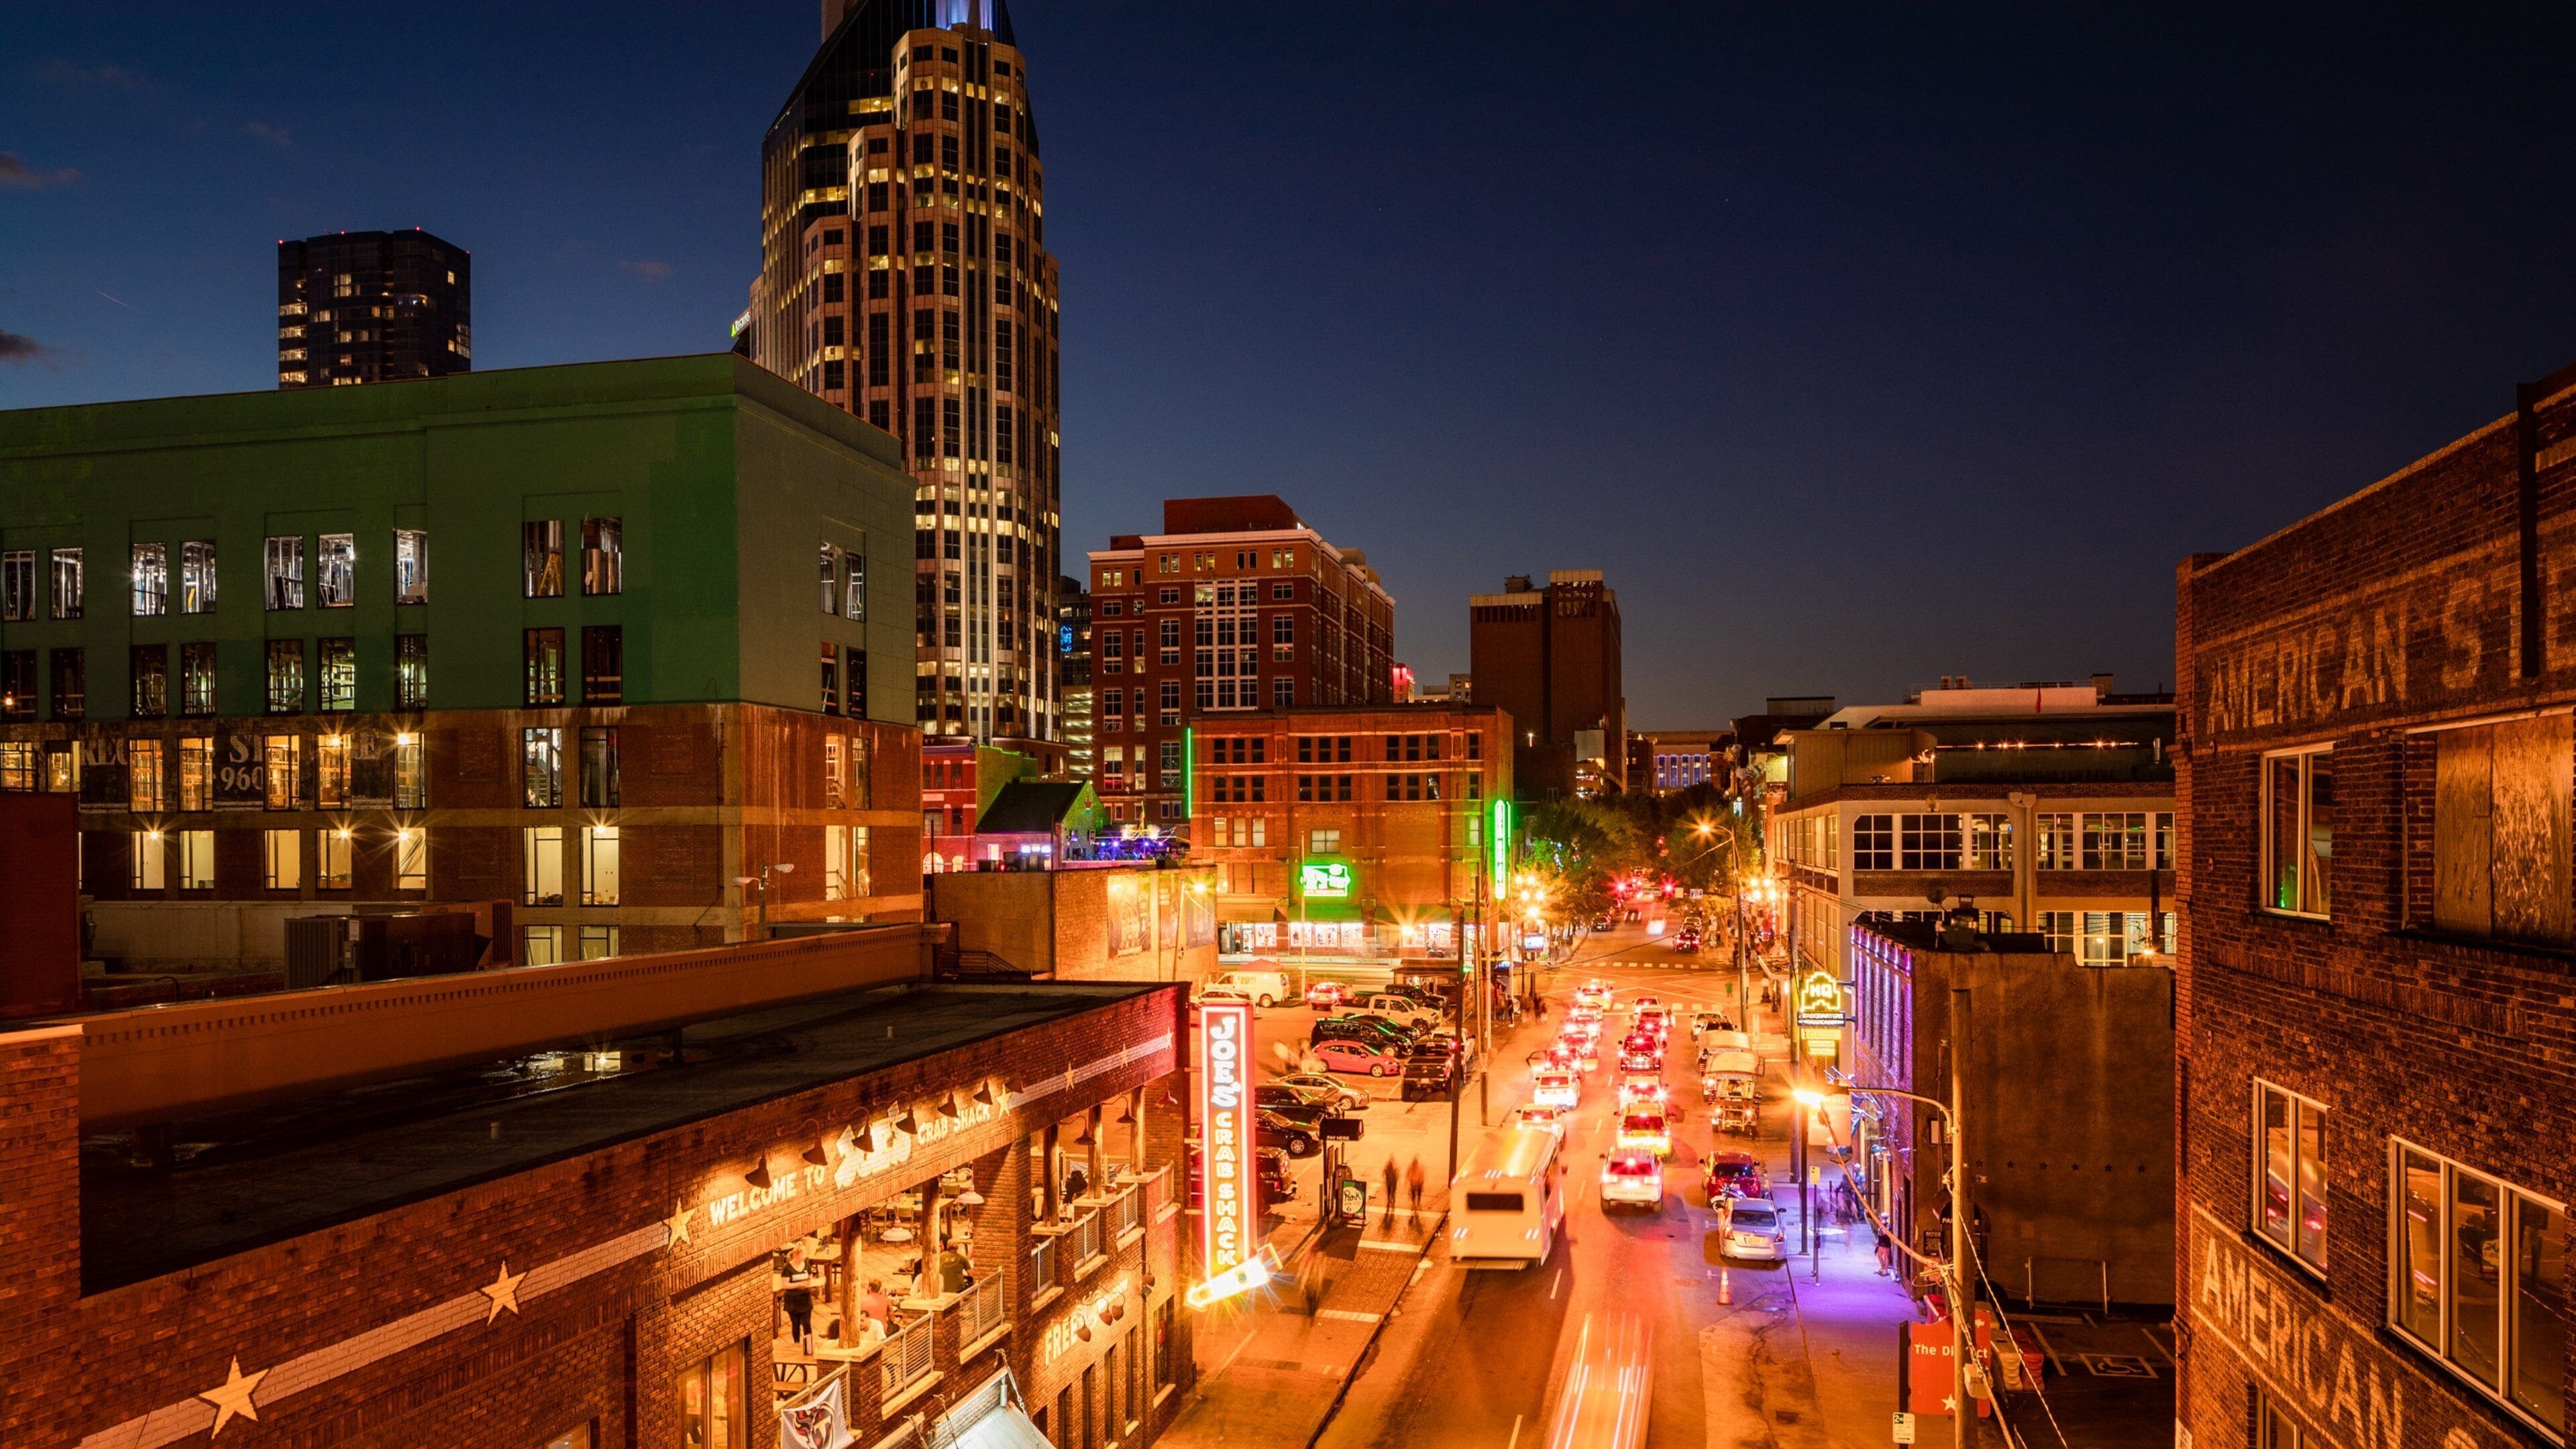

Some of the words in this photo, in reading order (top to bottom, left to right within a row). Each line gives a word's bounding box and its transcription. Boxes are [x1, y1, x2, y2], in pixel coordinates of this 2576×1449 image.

[2207, 603, 2407, 734] AMERICAN
[1810, 983, 1833, 998] HQ
[1210, 1016, 1241, 1107] JOE'S
[709, 1172, 797, 1226] WELCOME
[804, 1166, 825, 1190] TO
[918, 1116, 949, 1146] CRAB
[953, 1102, 990, 1134] SHACK
[1215, 1112, 1236, 1178] CRAB
[1216, 1183, 1237, 1266] SHACK
[1045, 1313, 1079, 1367] FREE
[1915, 1344, 1937, 1356] The
[2202, 1237, 2403, 1449] AMERICAN
